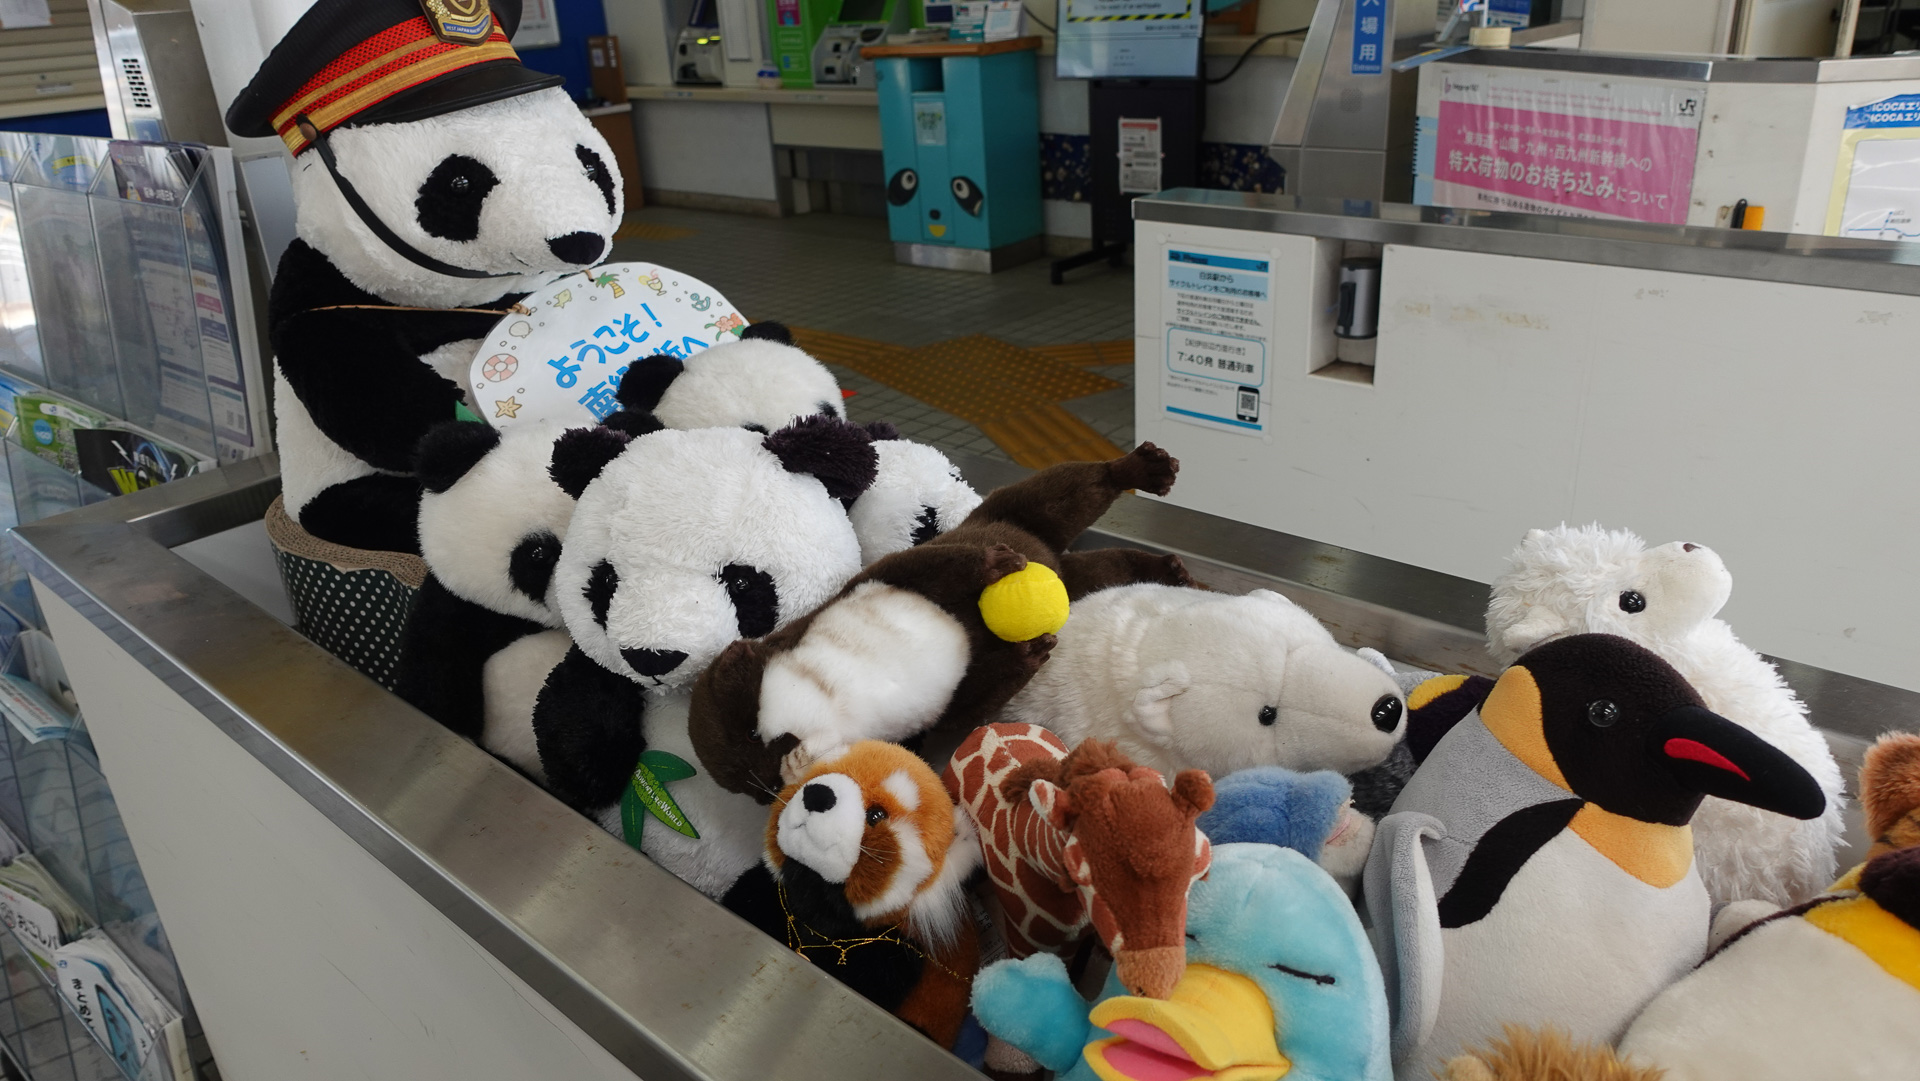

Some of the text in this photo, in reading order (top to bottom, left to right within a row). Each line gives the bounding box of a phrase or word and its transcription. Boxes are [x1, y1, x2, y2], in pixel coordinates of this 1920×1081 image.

[1448, 150, 1669, 209] 特大荷物のお持ち込みについて
[1218, 358, 1255, 374] 普通列車
